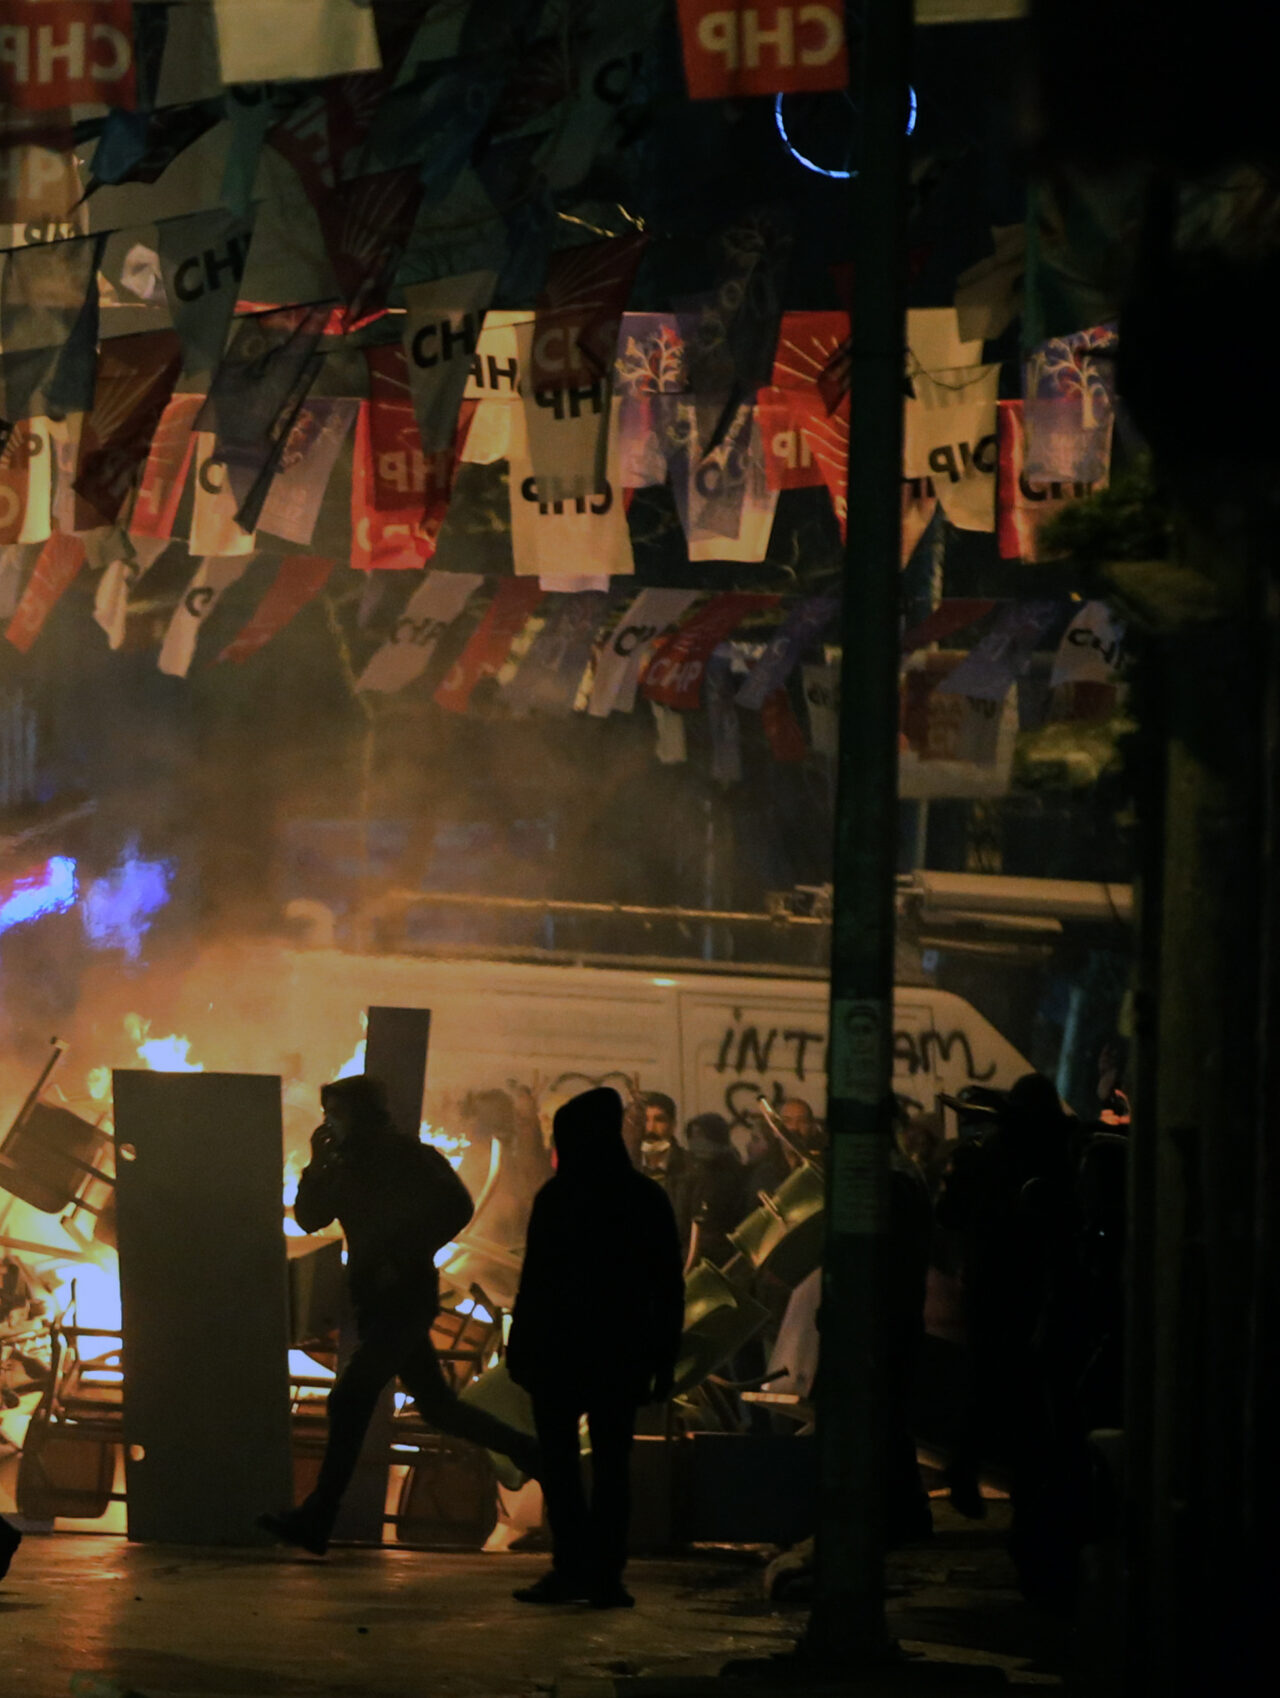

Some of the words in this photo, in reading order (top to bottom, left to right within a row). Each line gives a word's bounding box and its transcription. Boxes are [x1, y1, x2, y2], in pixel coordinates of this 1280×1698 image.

[174, 233, 252, 301] CH
[412, 308, 486, 368] CH
[645, 657, 703, 693] CHP
